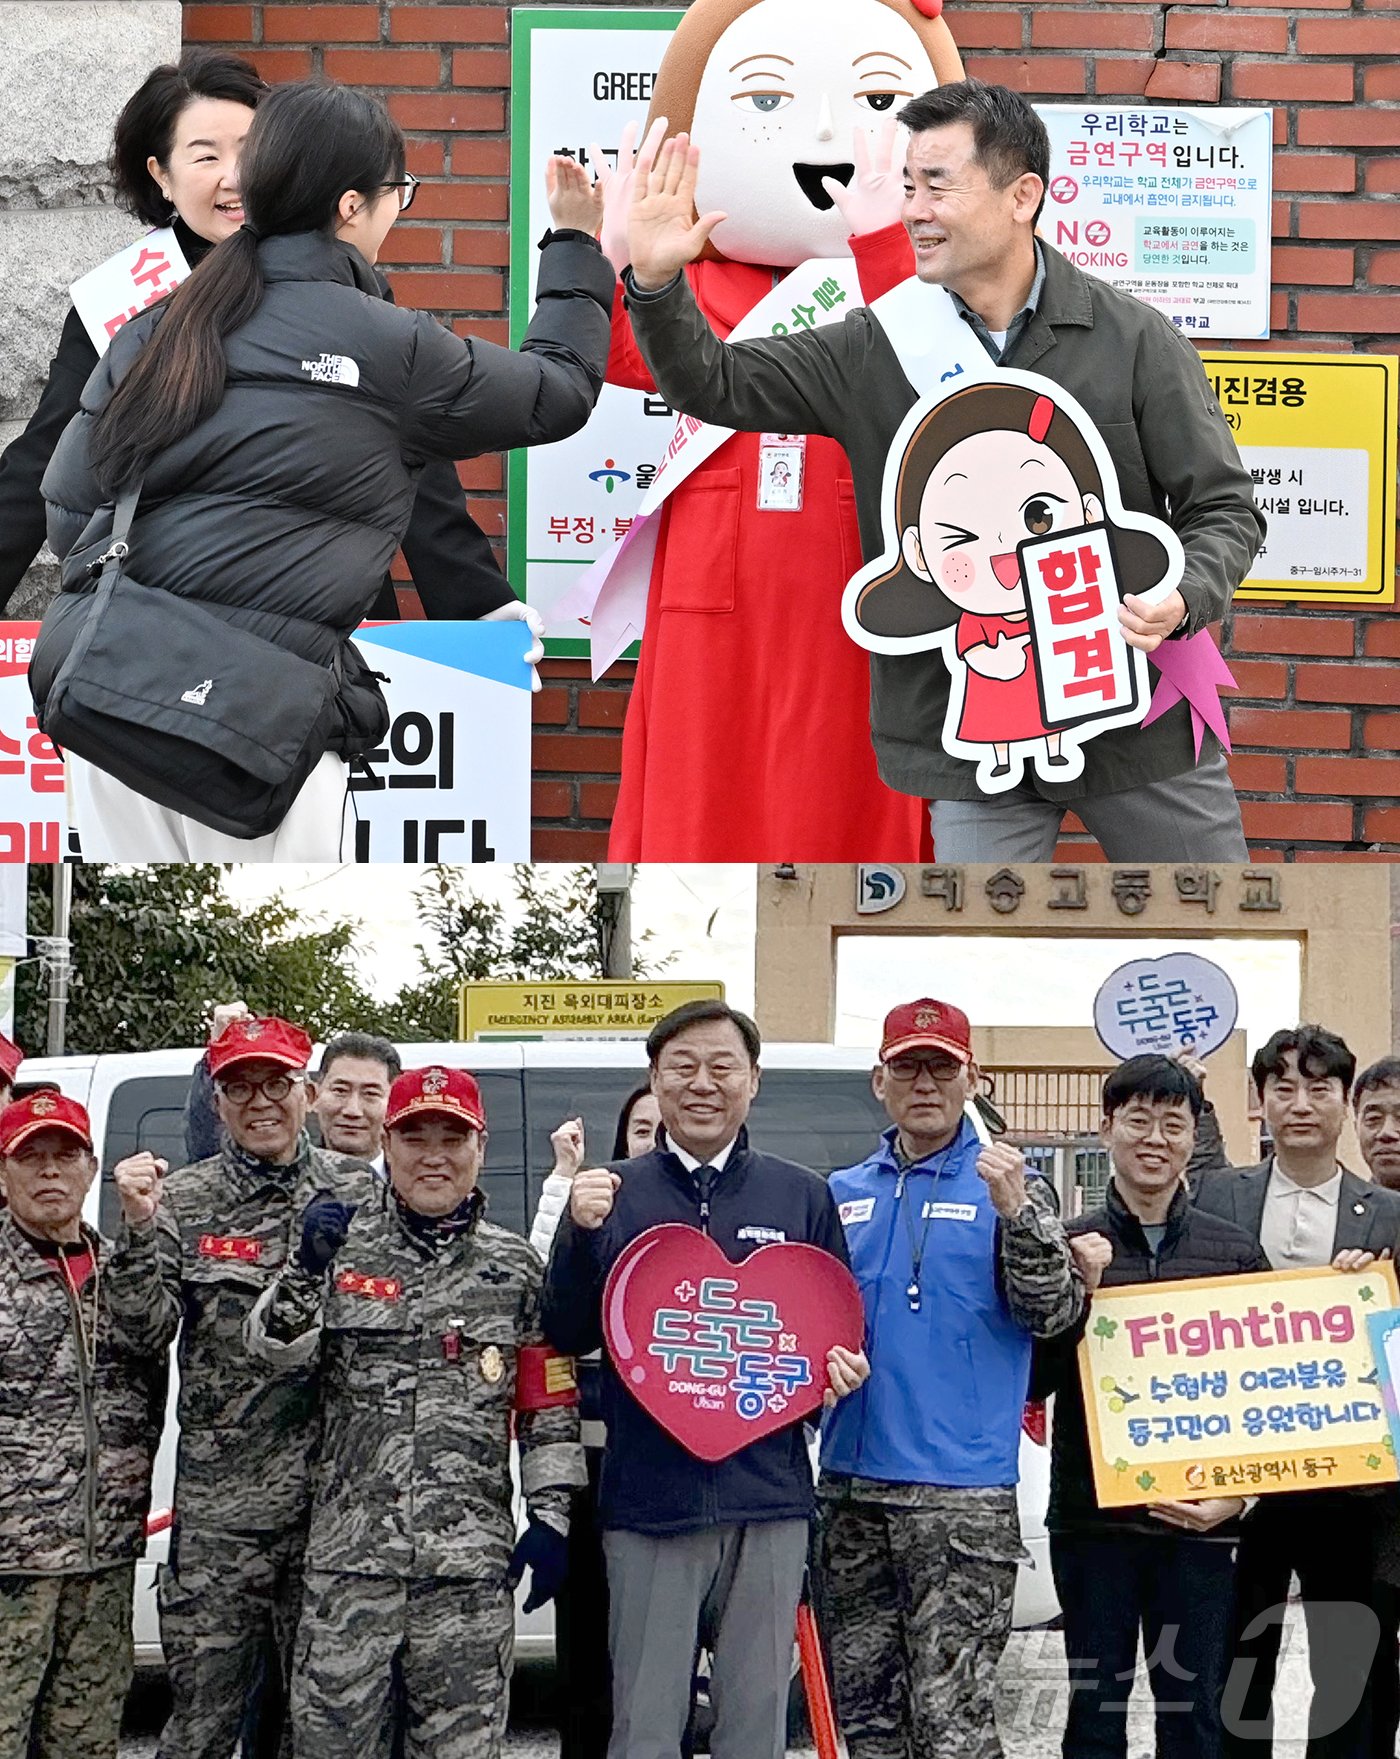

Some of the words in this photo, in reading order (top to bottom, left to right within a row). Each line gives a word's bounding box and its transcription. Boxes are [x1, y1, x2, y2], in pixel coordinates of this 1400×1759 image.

[1081, 113, 1189, 137] 우리학교는
[1066, 141, 1167, 168] 금연구역
[1172, 145, 1245, 169] 입니다.
[1081, 175, 1134, 188] 우리학교는
[1137, 176, 1158, 188] 학교
[1161, 176, 1192, 190] 전체가
[1194, 178, 1258, 190] 금연구역으로
[1102, 193, 1144, 205] 교내에서
[1147, 194, 1178, 206] 흡연이
[1143, 226, 1188, 237] 교육활동이
[1190, 227, 1235, 238] 이루어지는
[1143, 240, 1179, 250] 학교에서
[1181, 241, 1208, 251] 금연을
[1211, 242, 1229, 251] 하는
[1231, 242, 1249, 252] 것은
[1143, 253, 1170, 264] 당연한
[1172, 254, 1211, 265] 것입니다.
[301, 360, 341, 373] NORTH
[319, 353, 342, 364] THE
[311, 370, 340, 383] FACE
[1288, 470, 1303, 486] 시
[1298, 499, 1349, 516] 입니다.
[1037, 545, 1116, 701] 합격
[921, 867, 1282, 915] 대송고등학교
[523, 993, 556, 1012] 지진
[1123, 1301, 1355, 1359] Fighting
[1150, 1369, 1228, 1404] 수험생
[1127, 1414, 1231, 1447] 동구민이
[1242, 1401, 1381, 1438] 응원합니다
[1212, 1462, 1298, 1487] 울산광역시
[1302, 1456, 1338, 1479] 동구
